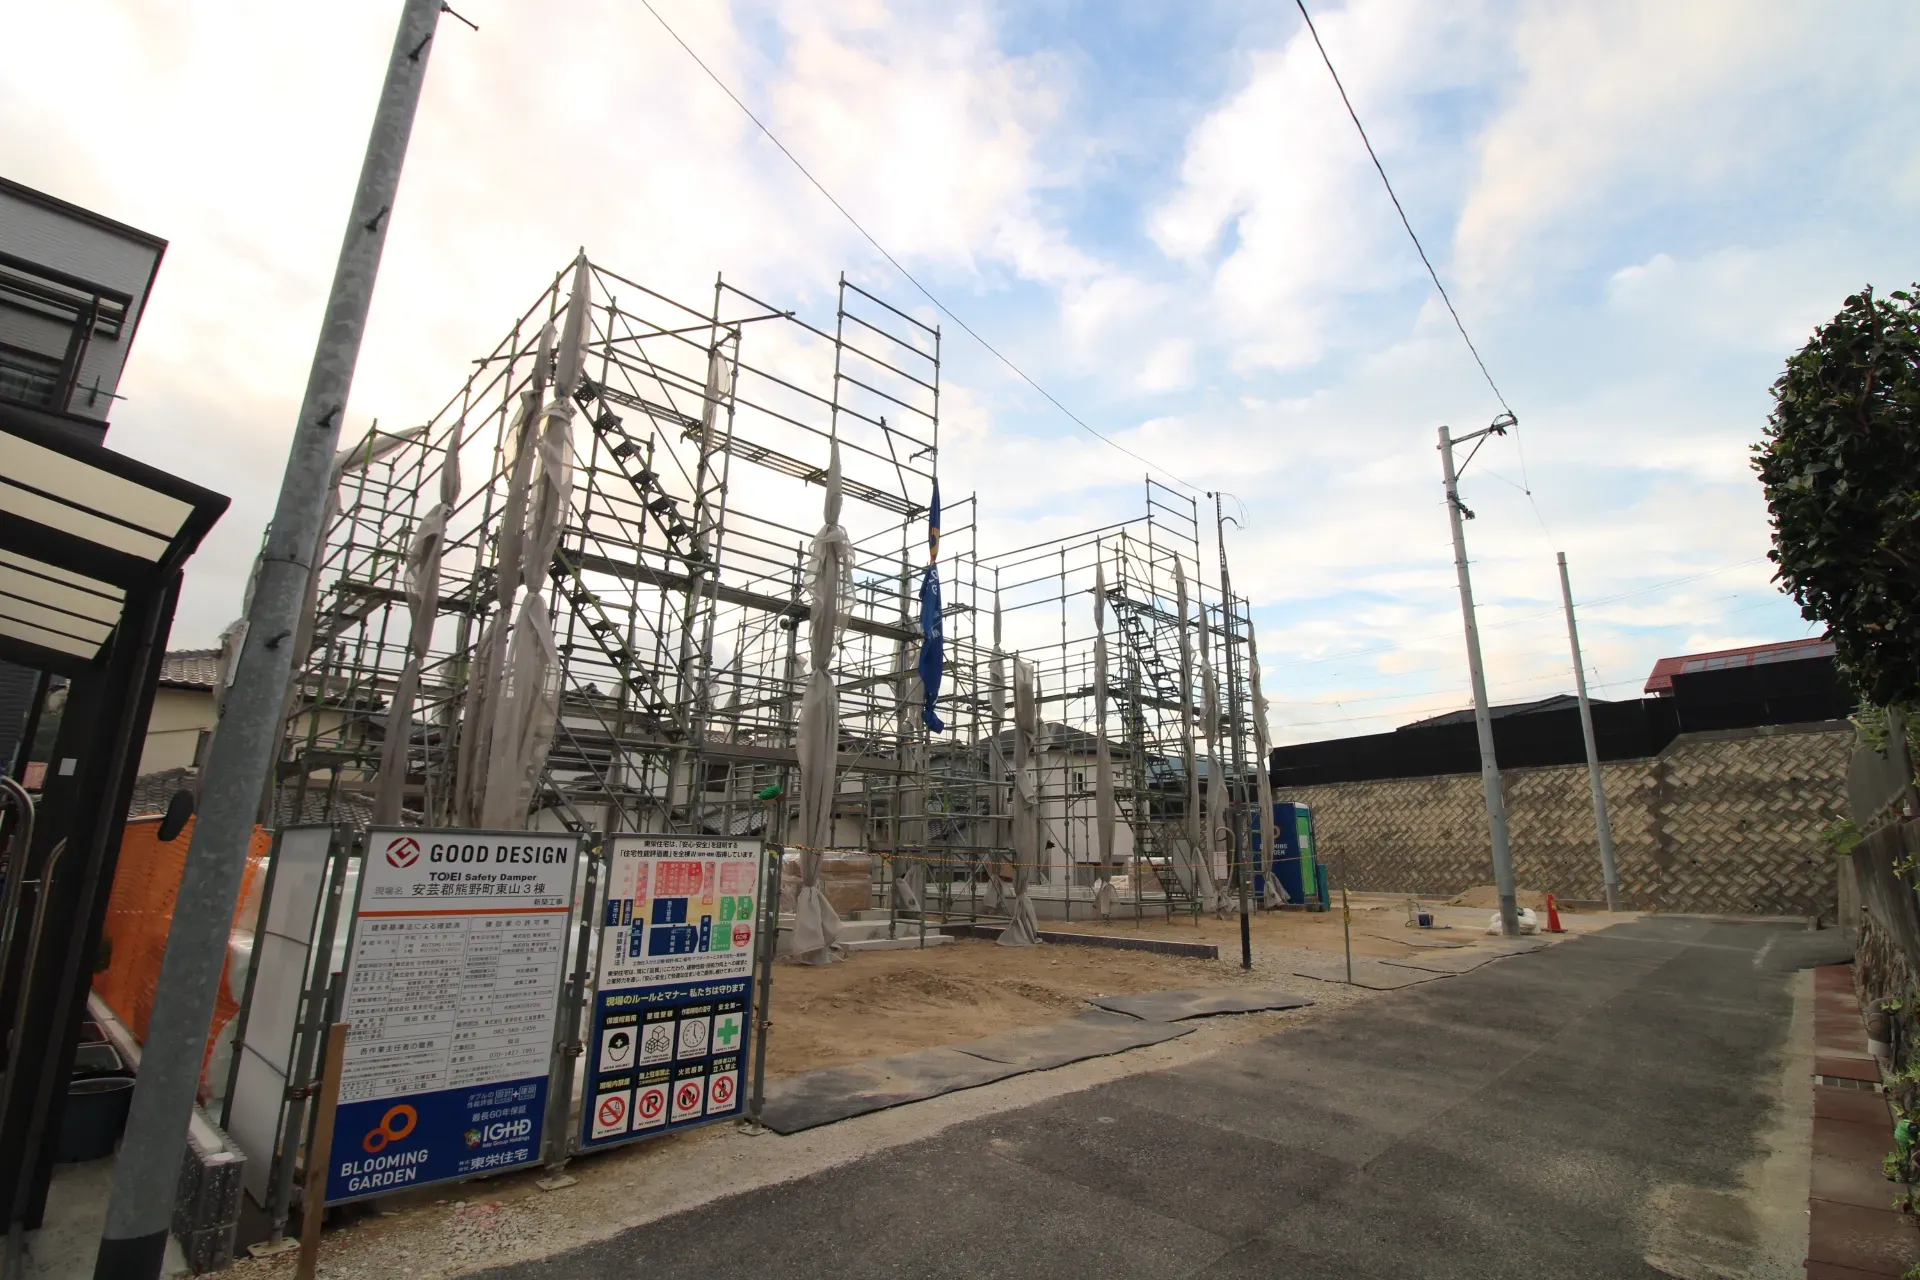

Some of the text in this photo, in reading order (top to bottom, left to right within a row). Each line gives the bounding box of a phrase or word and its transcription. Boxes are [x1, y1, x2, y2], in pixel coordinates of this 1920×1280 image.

[430, 844, 567, 863] GOOD DESIGN
[465, 874, 497, 882] Safety
[375, 887, 403, 895] 現場名
[689, 983, 745, 997] 私たちは守ります
[341, 1149, 428, 1177] BLOOMING
[470, 1149, 528, 1170] 東栄住宅
[348, 1167, 416, 1192] GARDEN
